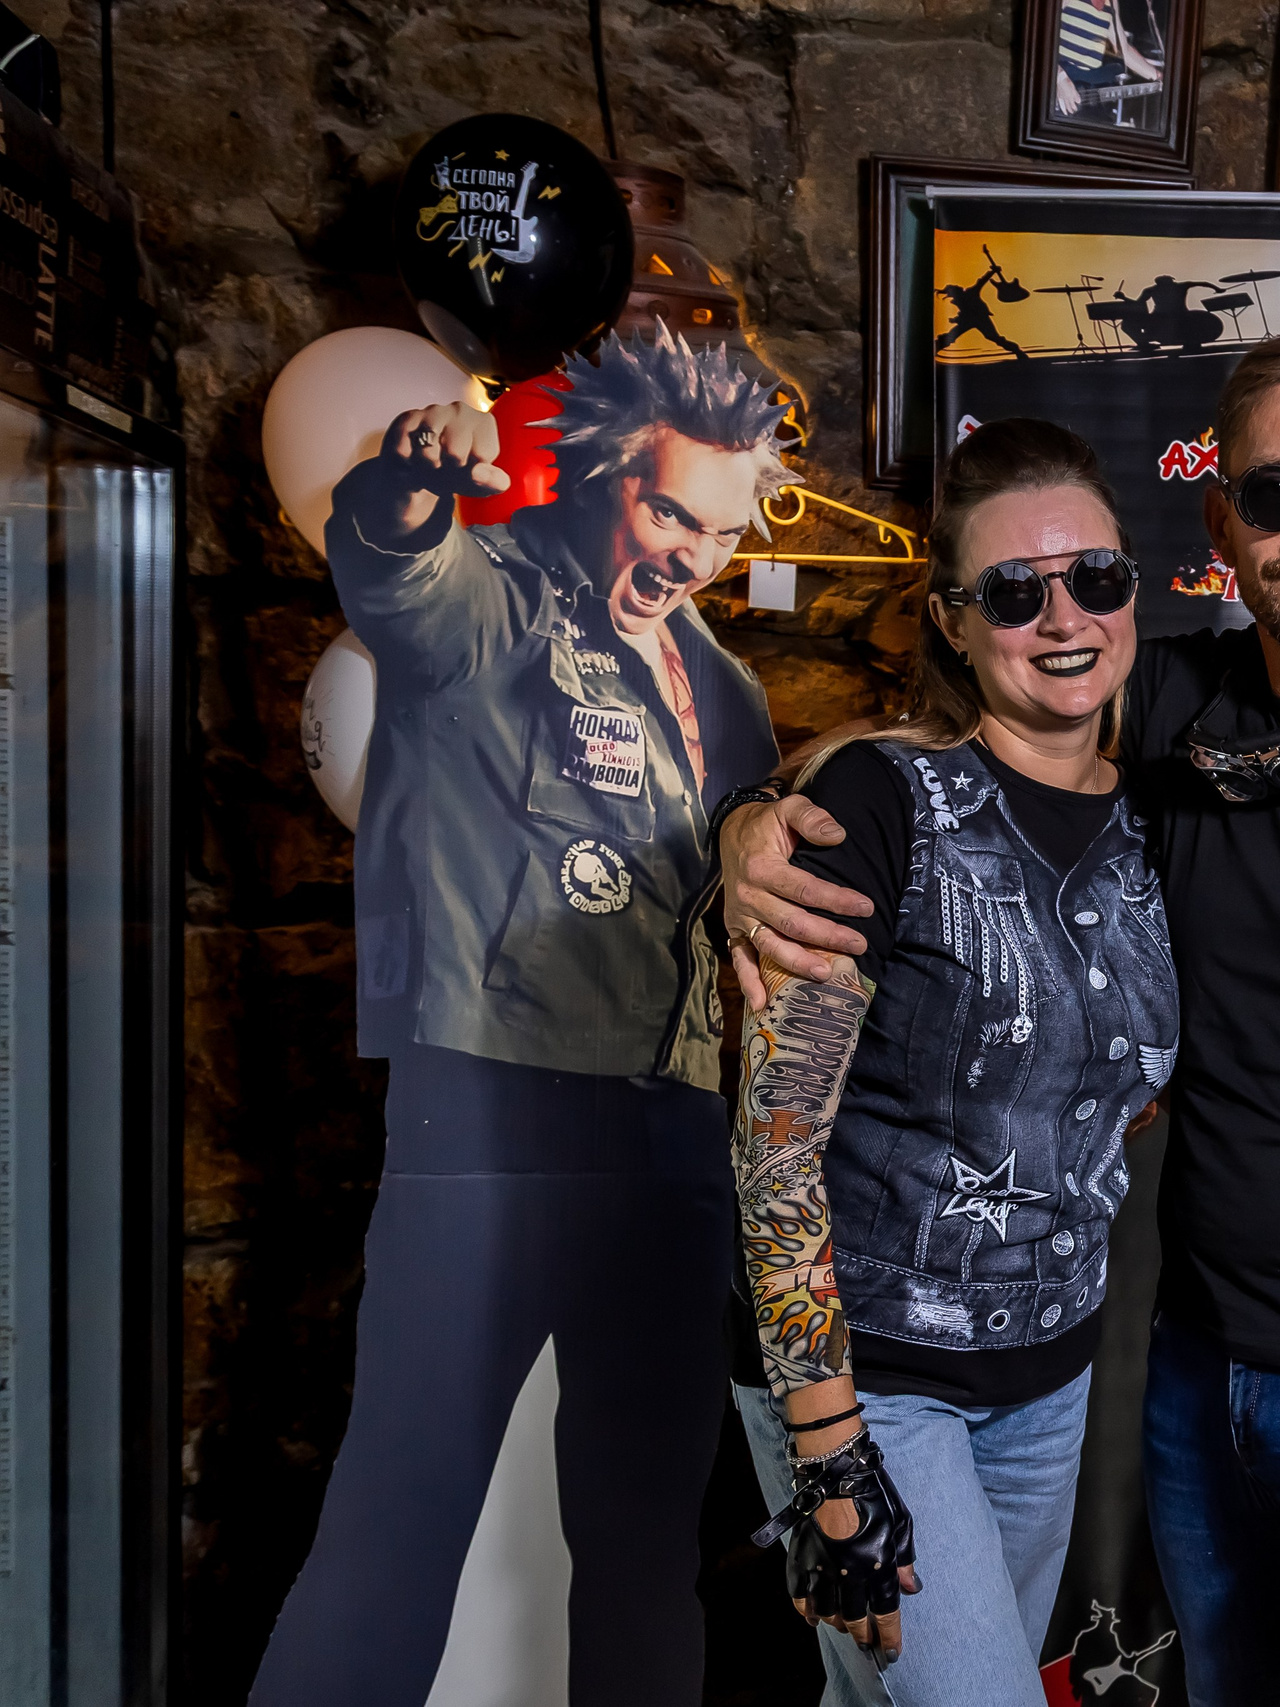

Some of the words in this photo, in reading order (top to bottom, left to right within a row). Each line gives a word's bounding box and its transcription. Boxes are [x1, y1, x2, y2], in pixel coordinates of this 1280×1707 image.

[453, 168, 516, 189] СЕГОДНЯ
[458, 189, 510, 213] ТВОЙ
[447, 214, 517, 243] ДЕНЬ!
[33, 241, 59, 352] LATTE
[912, 757, 960, 831] LOVE
[964, 1197, 1020, 1223] Star
